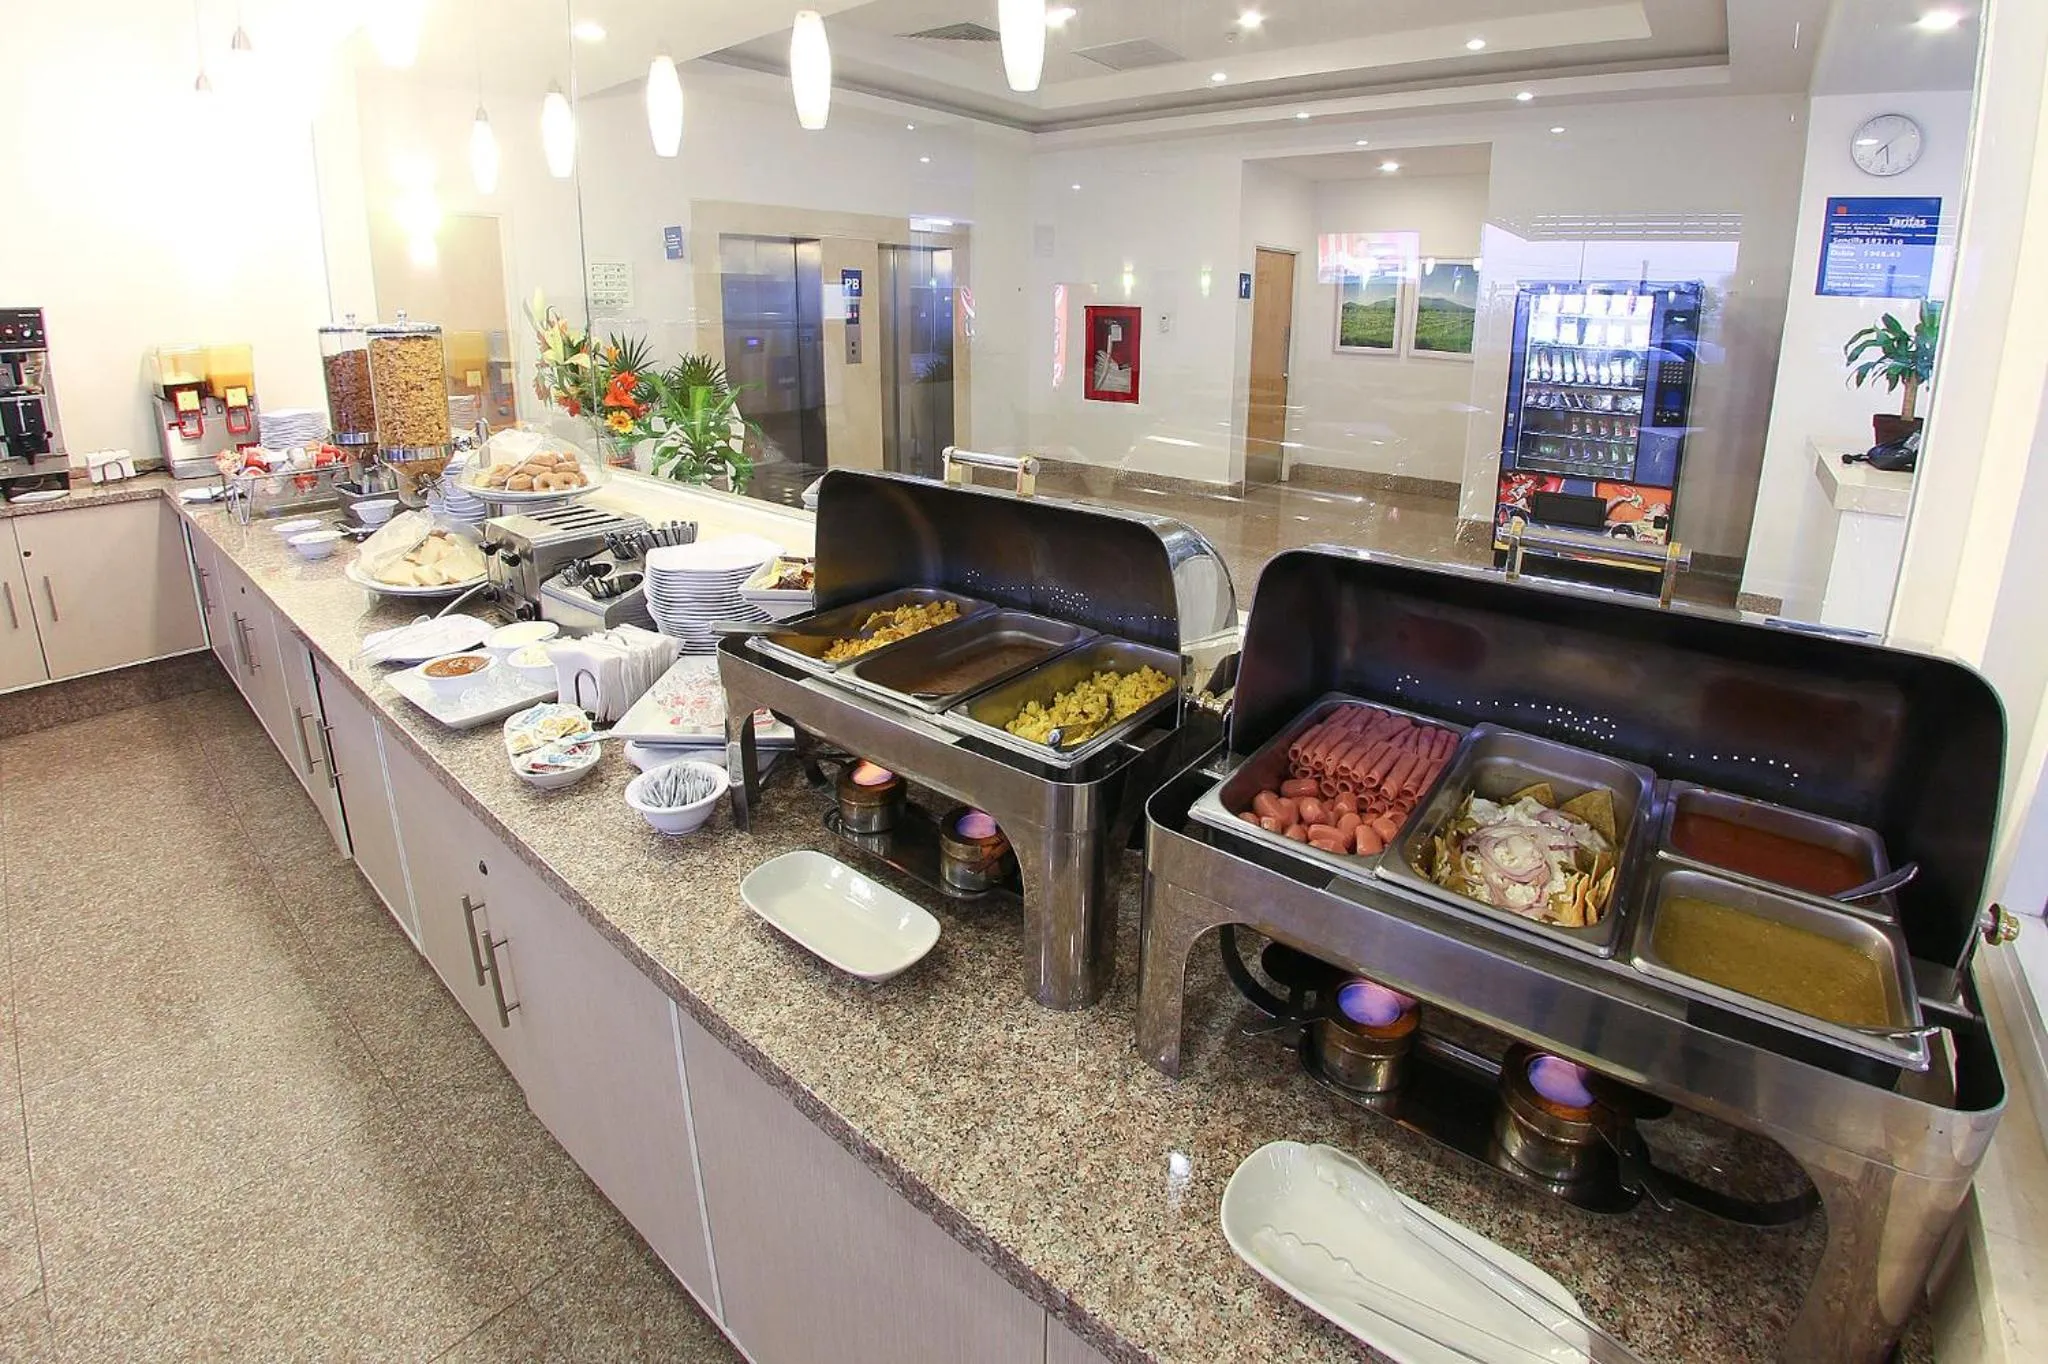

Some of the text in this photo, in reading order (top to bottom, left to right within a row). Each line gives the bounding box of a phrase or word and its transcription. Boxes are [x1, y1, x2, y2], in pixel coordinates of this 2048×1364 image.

[1888, 217, 1927, 228] Tarifas
[1830, 249, 1855, 257] Doble
[845, 278, 860, 290] PB
